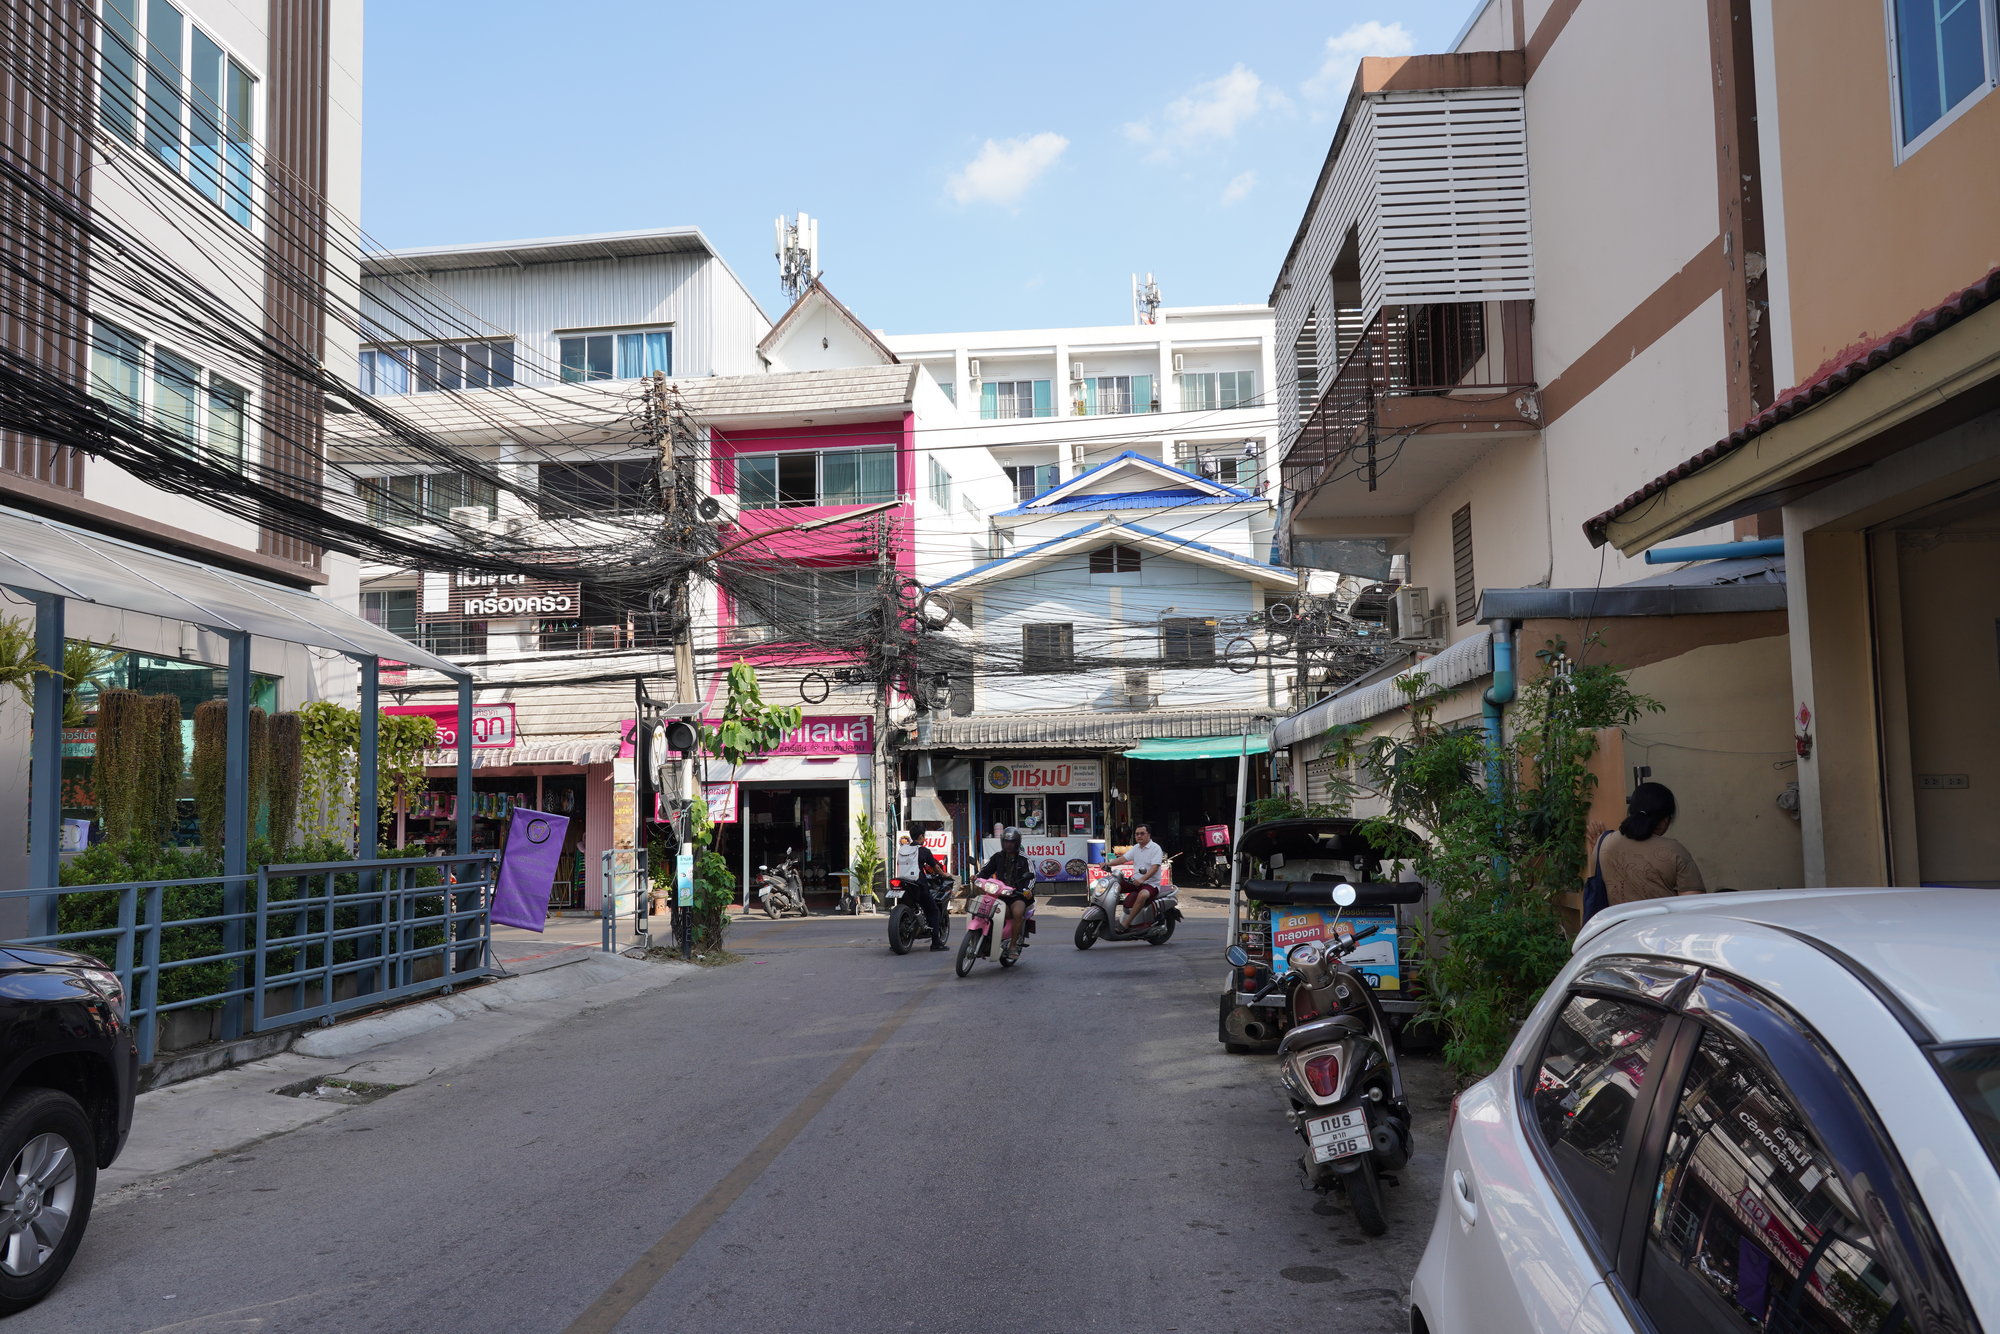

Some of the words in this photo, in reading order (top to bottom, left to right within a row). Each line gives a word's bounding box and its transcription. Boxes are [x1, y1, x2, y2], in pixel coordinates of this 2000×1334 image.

[464, 587, 571, 615] เครื่องครัว
[1011, 764, 1071, 787] แชมป์
[1026, 841, 1066, 856] แชมป์
[1288, 916, 1308, 927] ลด
[1277, 927, 1321, 943] ทะลุองศา
[1321, 1115, 1352, 1132] กยธ
[1332, 1132, 1347, 1141] ตาก
[1327, 1139, 1358, 1157] 506
